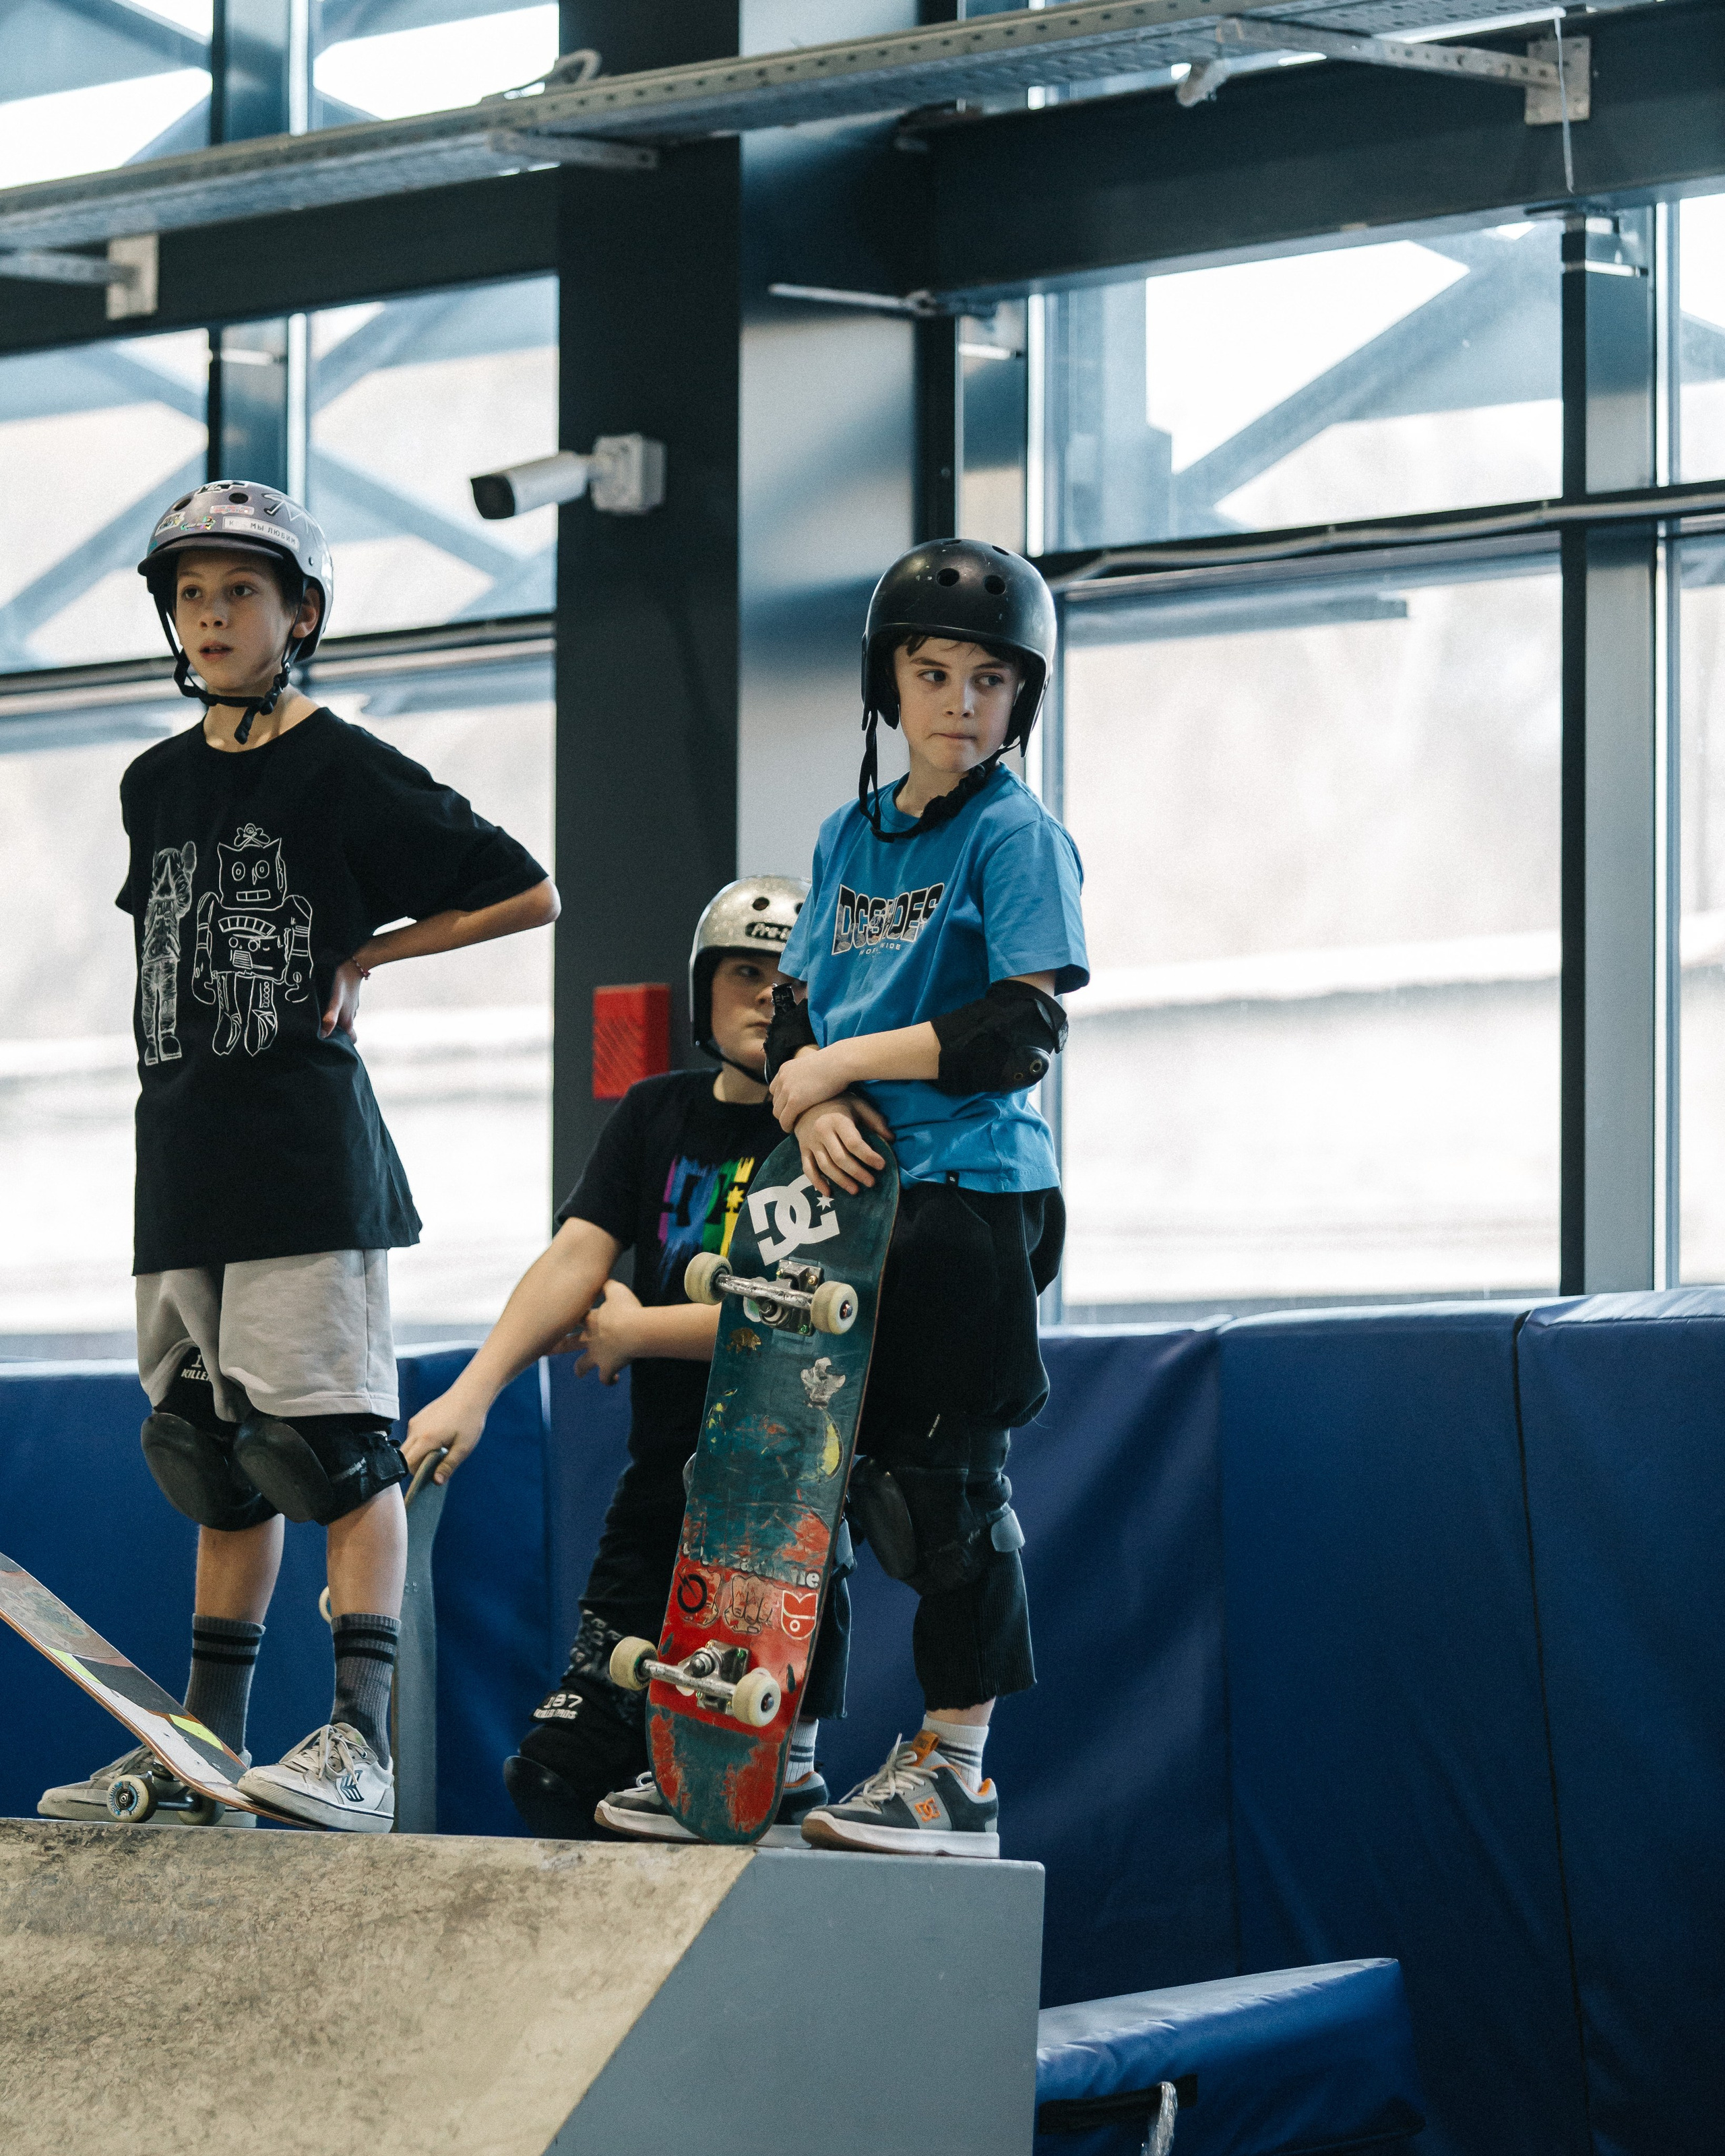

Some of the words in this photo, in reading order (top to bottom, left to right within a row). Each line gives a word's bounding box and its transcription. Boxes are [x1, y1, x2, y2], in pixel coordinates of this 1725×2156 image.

[747, 1174, 840, 1266] DC
[181, 1368, 210, 1381] KILLE
[543, 1693, 583, 1709] 187
